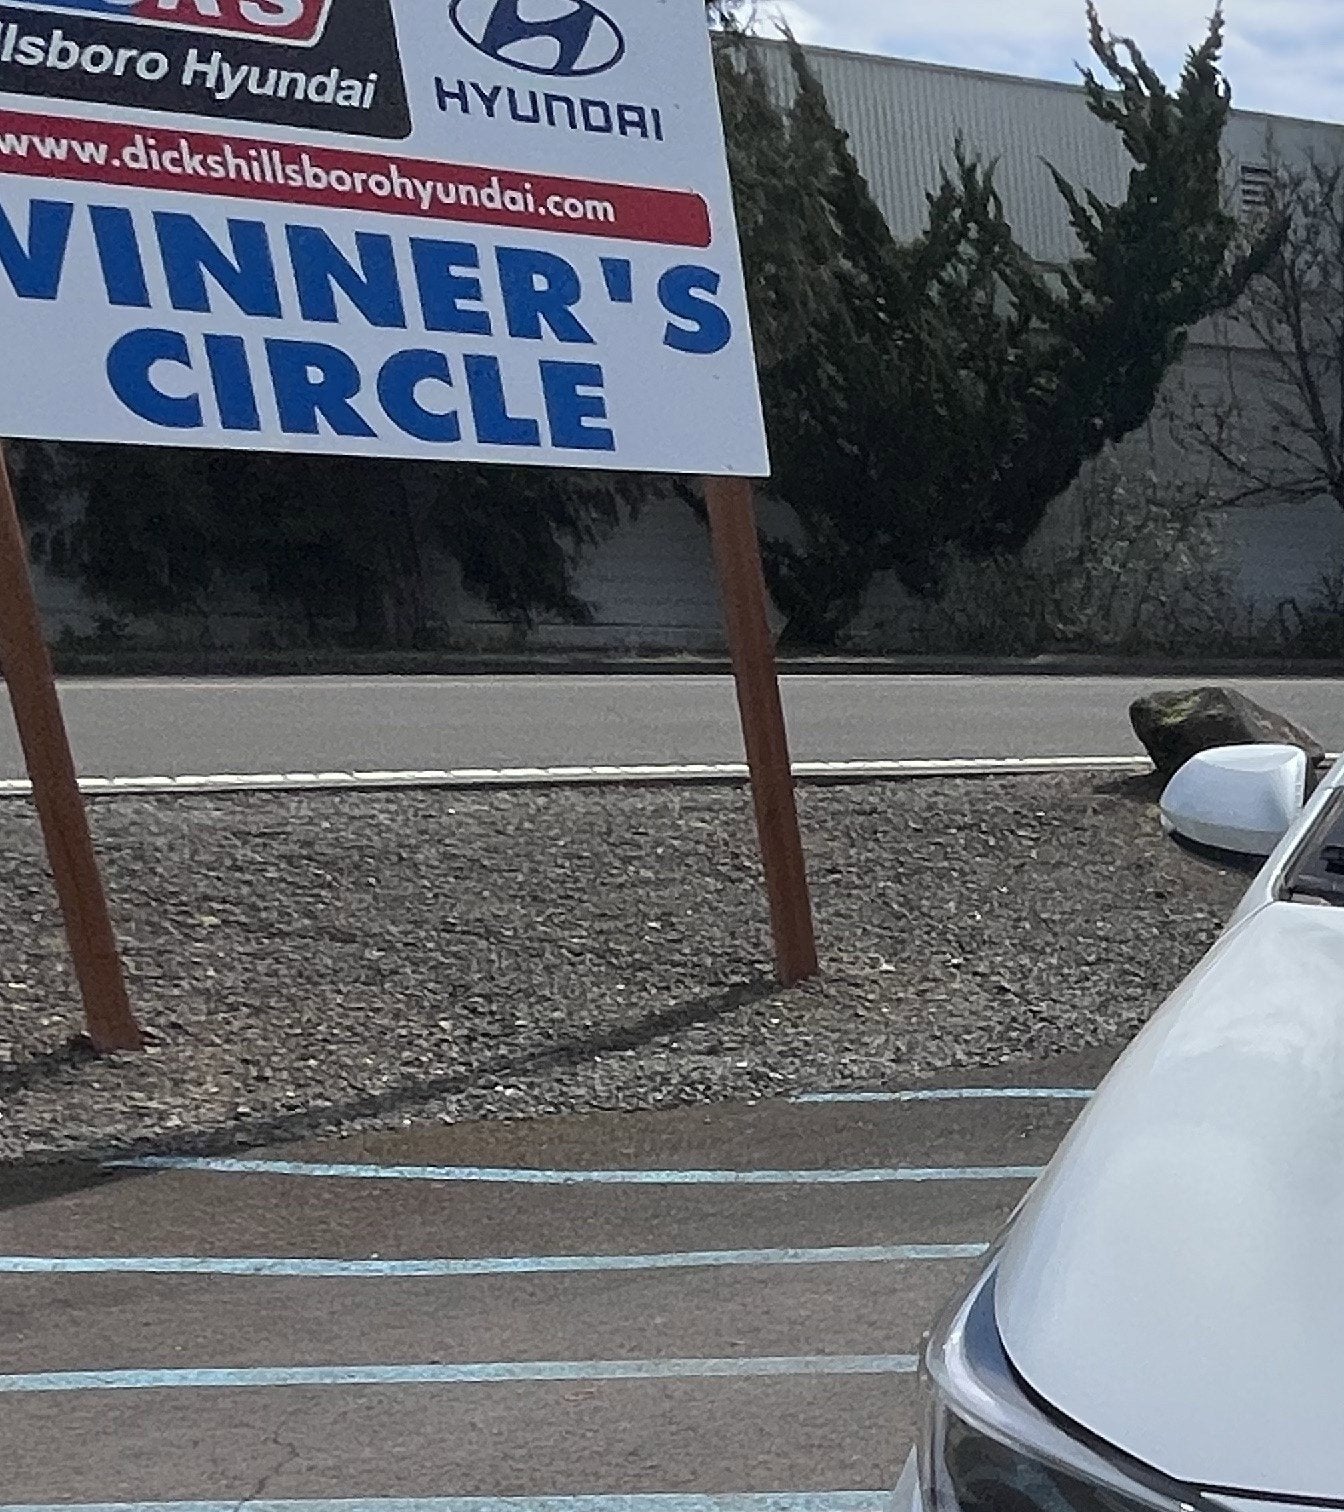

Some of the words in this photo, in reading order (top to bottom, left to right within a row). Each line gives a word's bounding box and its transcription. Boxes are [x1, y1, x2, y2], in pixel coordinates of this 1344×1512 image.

[0, 20, 170, 81] lsboro
[182, 48, 378, 109] Hyundai
[434, 76, 663, 141] HYUNDAI
[0, 132, 616, 223] www.dickshillsborohyundai.com
[106, 327, 616, 451] CIRCLE
